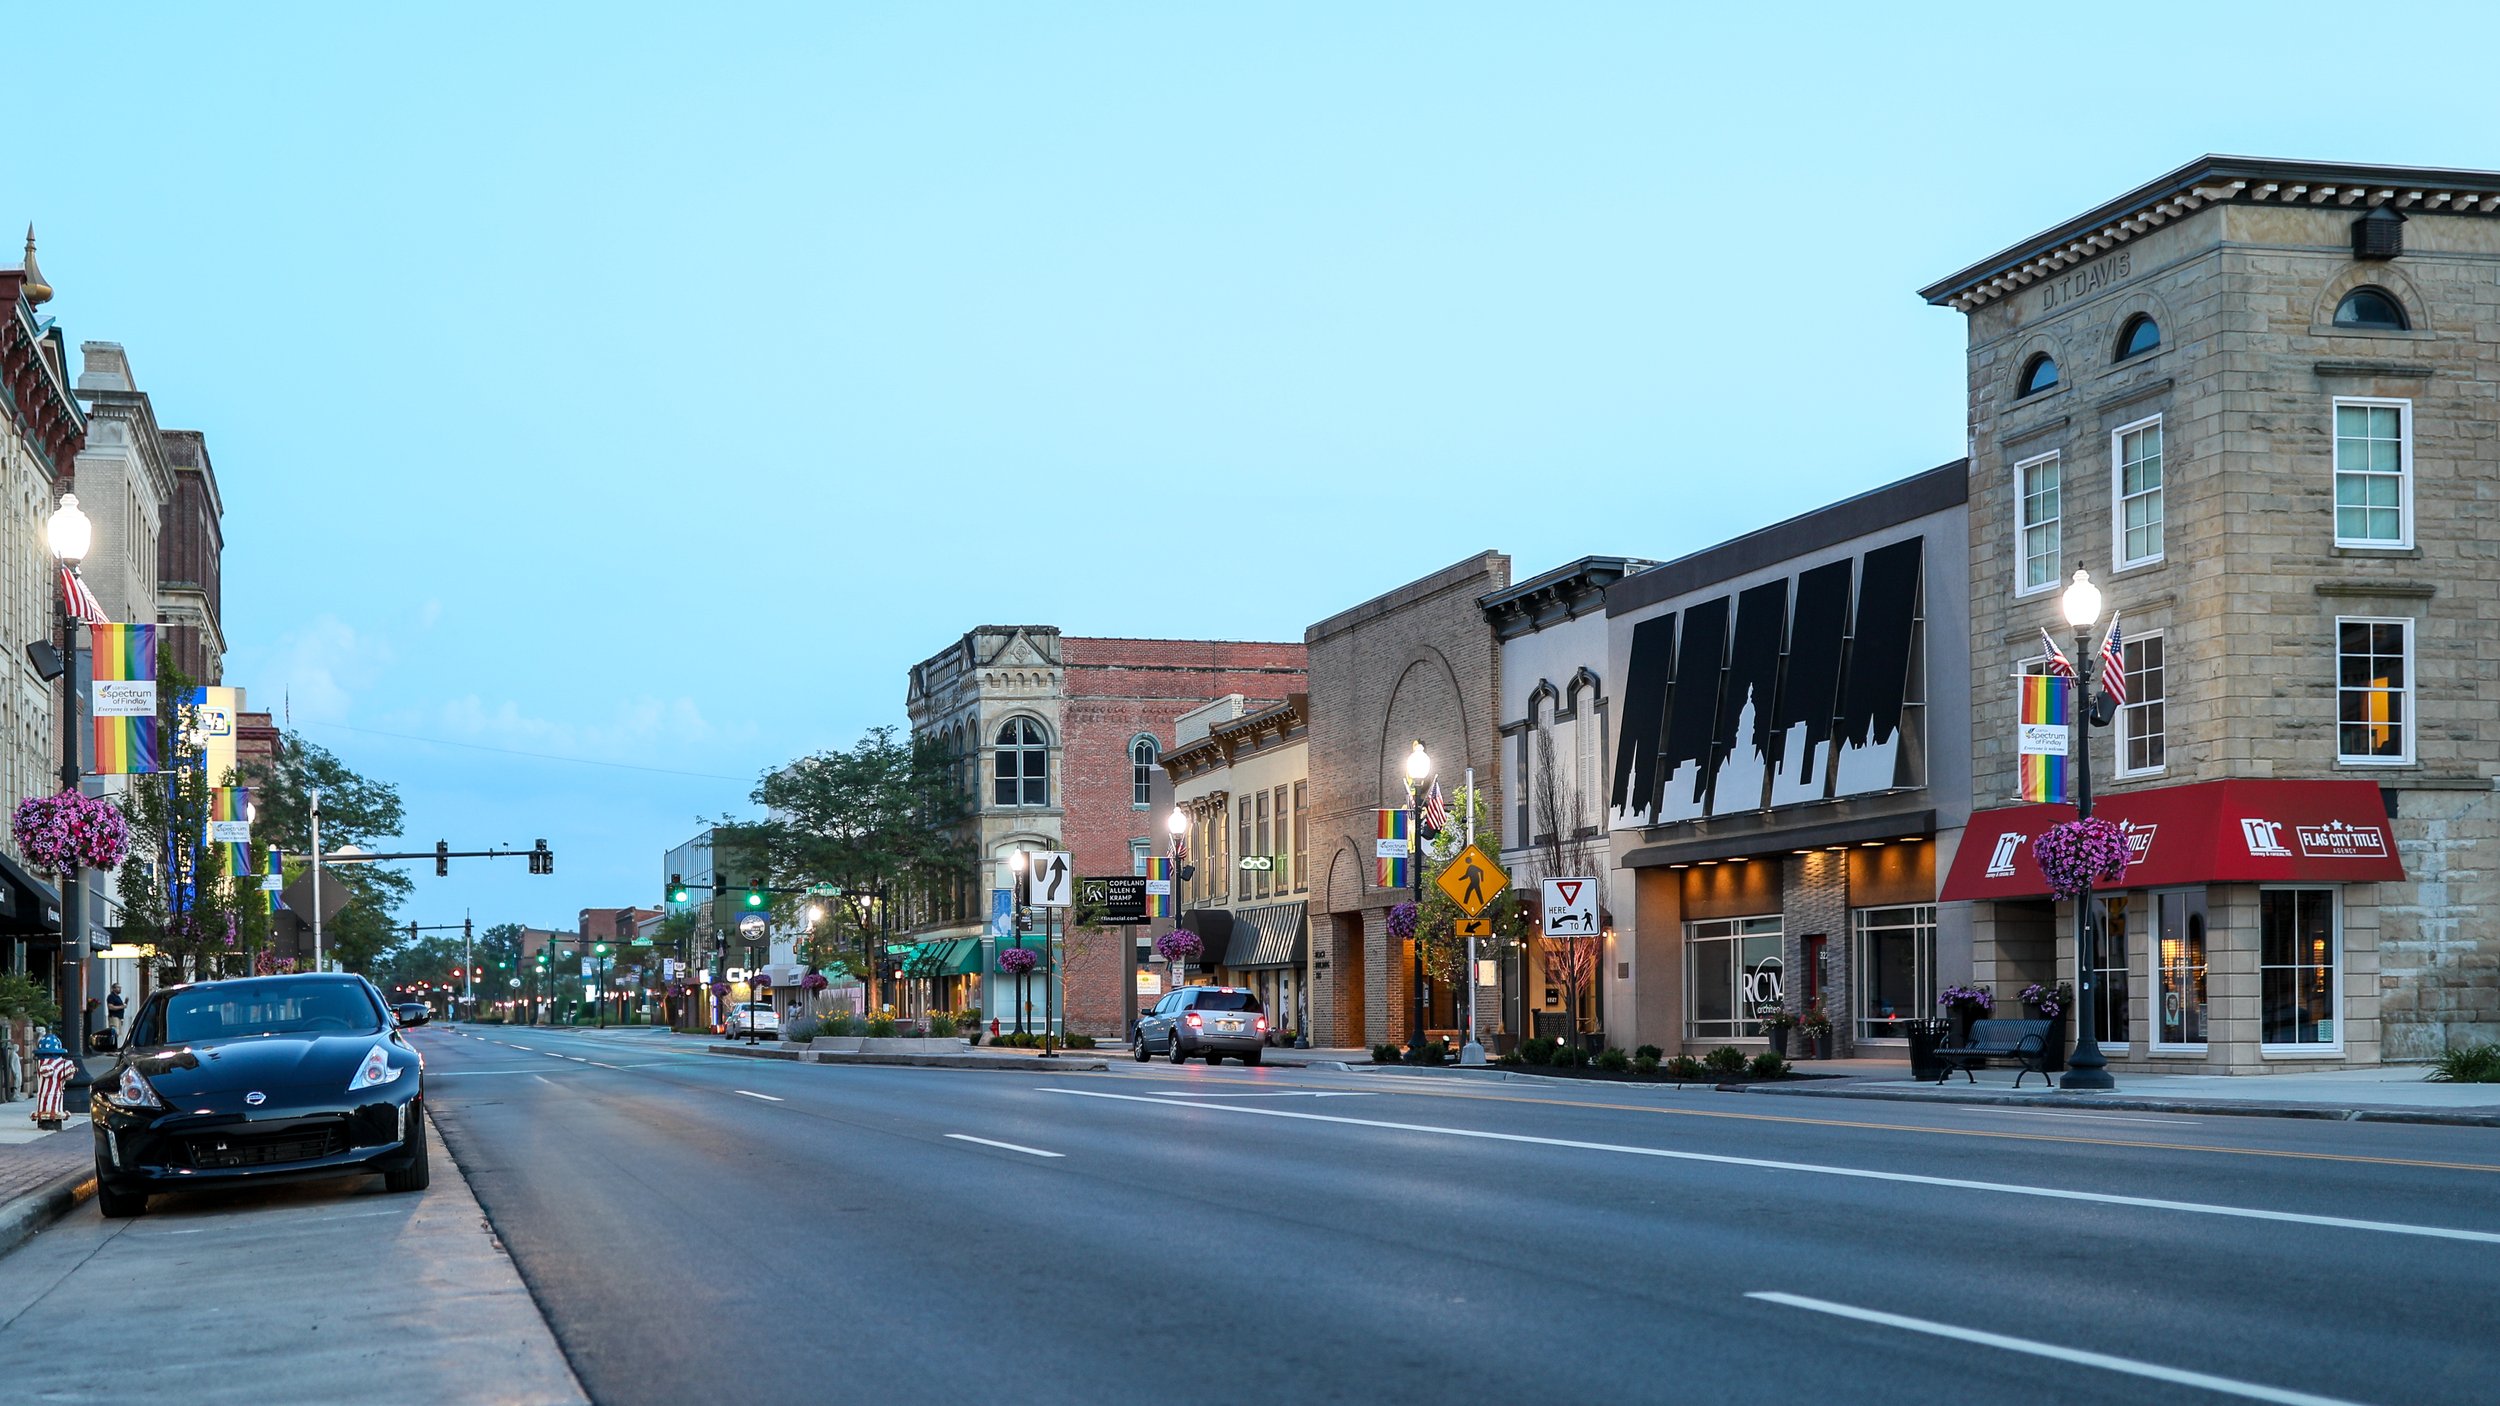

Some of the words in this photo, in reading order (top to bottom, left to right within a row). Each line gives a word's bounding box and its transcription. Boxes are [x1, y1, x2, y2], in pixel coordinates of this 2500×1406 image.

[107, 690, 151, 699] spectrum
[2302, 833, 2329, 847] FLAG
[2330, 833, 2352, 847] CITY
[2352, 833, 2380, 847] TITLE
[1743, 972, 1784, 1002] RCM
